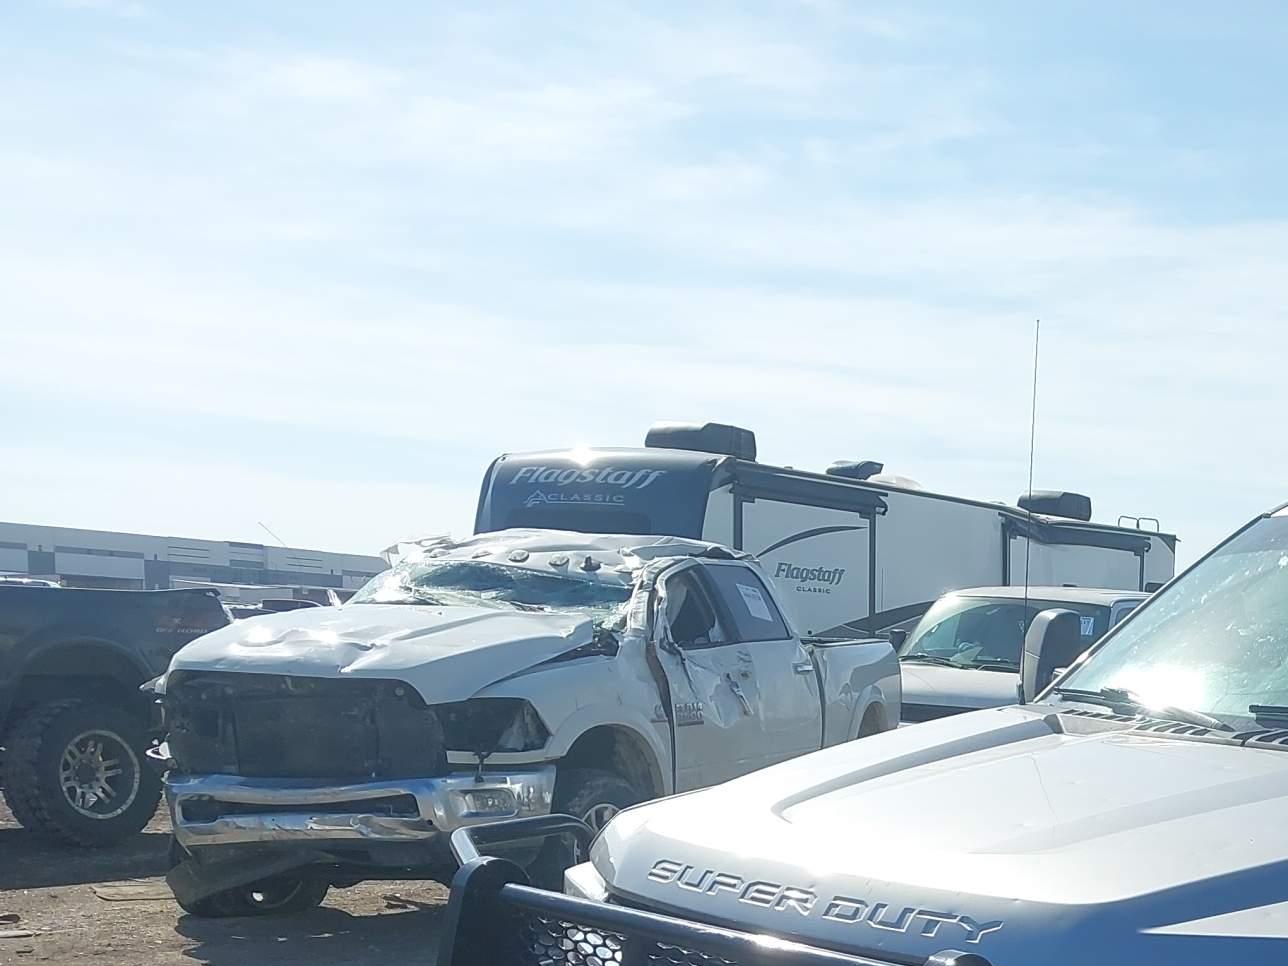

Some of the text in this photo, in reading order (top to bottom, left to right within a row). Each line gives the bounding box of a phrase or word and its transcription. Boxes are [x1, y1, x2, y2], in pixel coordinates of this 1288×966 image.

[510, 466, 667, 489] Flagstaff
[547, 493, 625, 503] CLASSIC
[775, 562, 845, 585] Flagstaff
[796, 586, 831, 594] CLASSIC
[647, 858, 1004, 943] SUPER DUTY
